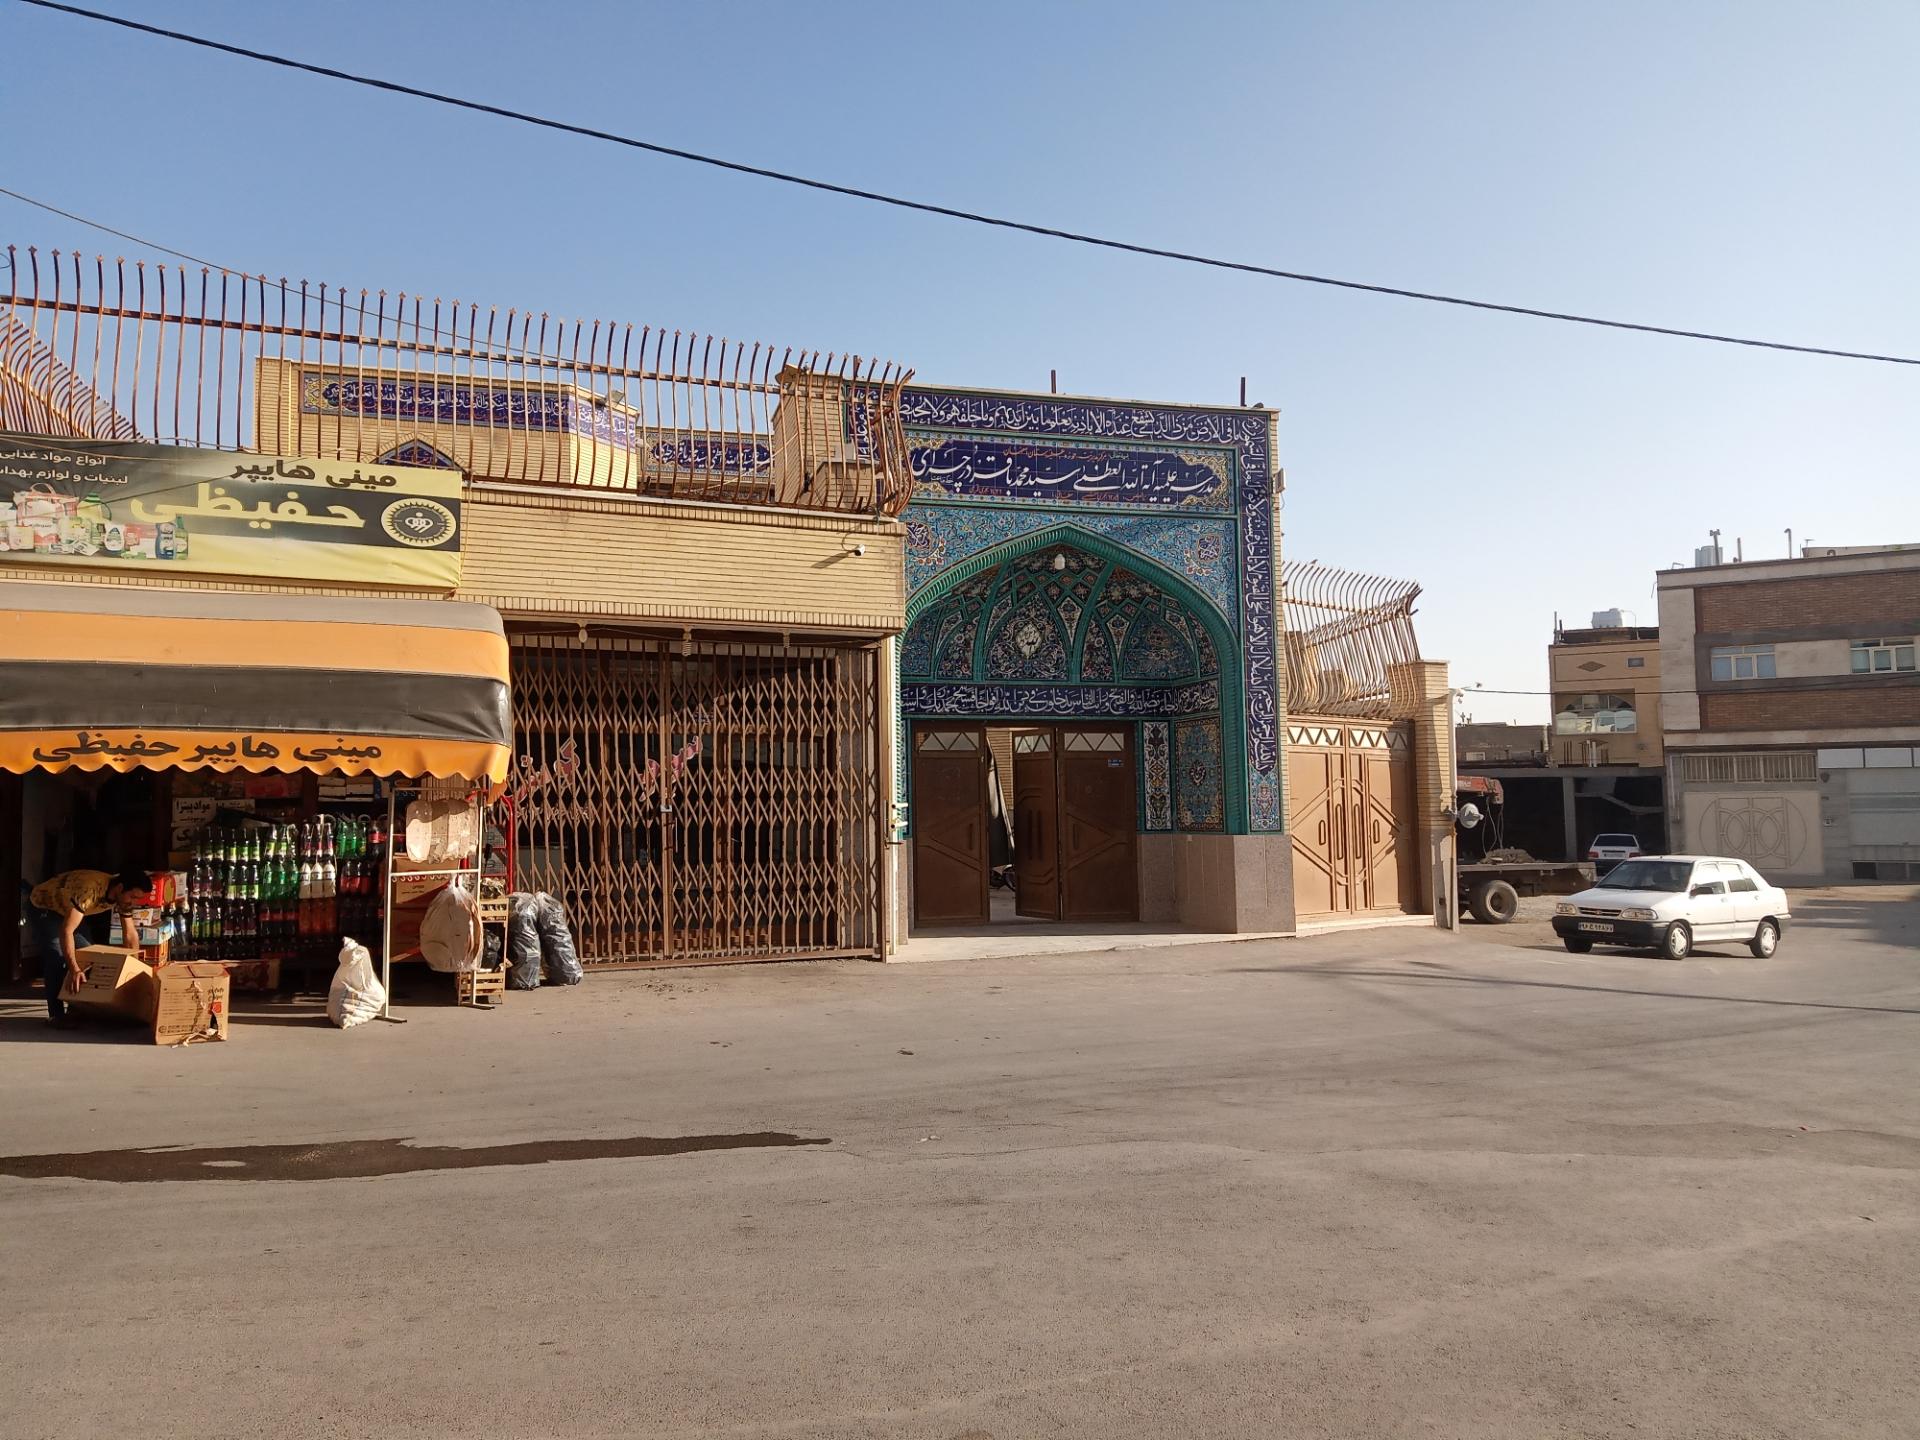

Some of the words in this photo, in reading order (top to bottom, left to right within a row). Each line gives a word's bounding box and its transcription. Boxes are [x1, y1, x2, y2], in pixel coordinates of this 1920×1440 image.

[41, 451, 72, 463] مواد
[76, 455, 107, 466] انواع
[36, 470, 70, 480] لوازم
[73, 473, 82, 482] و
[83, 474, 128, 485] لبنیات
[229, 460, 316, 483] هایپر
[325, 470, 397, 490] مینی
[130, 482, 366, 530] حفیظی
[33, 731, 180, 762] حفیظی
[183, 735, 280, 763] هایپر
[293, 738, 382, 763] مینی
